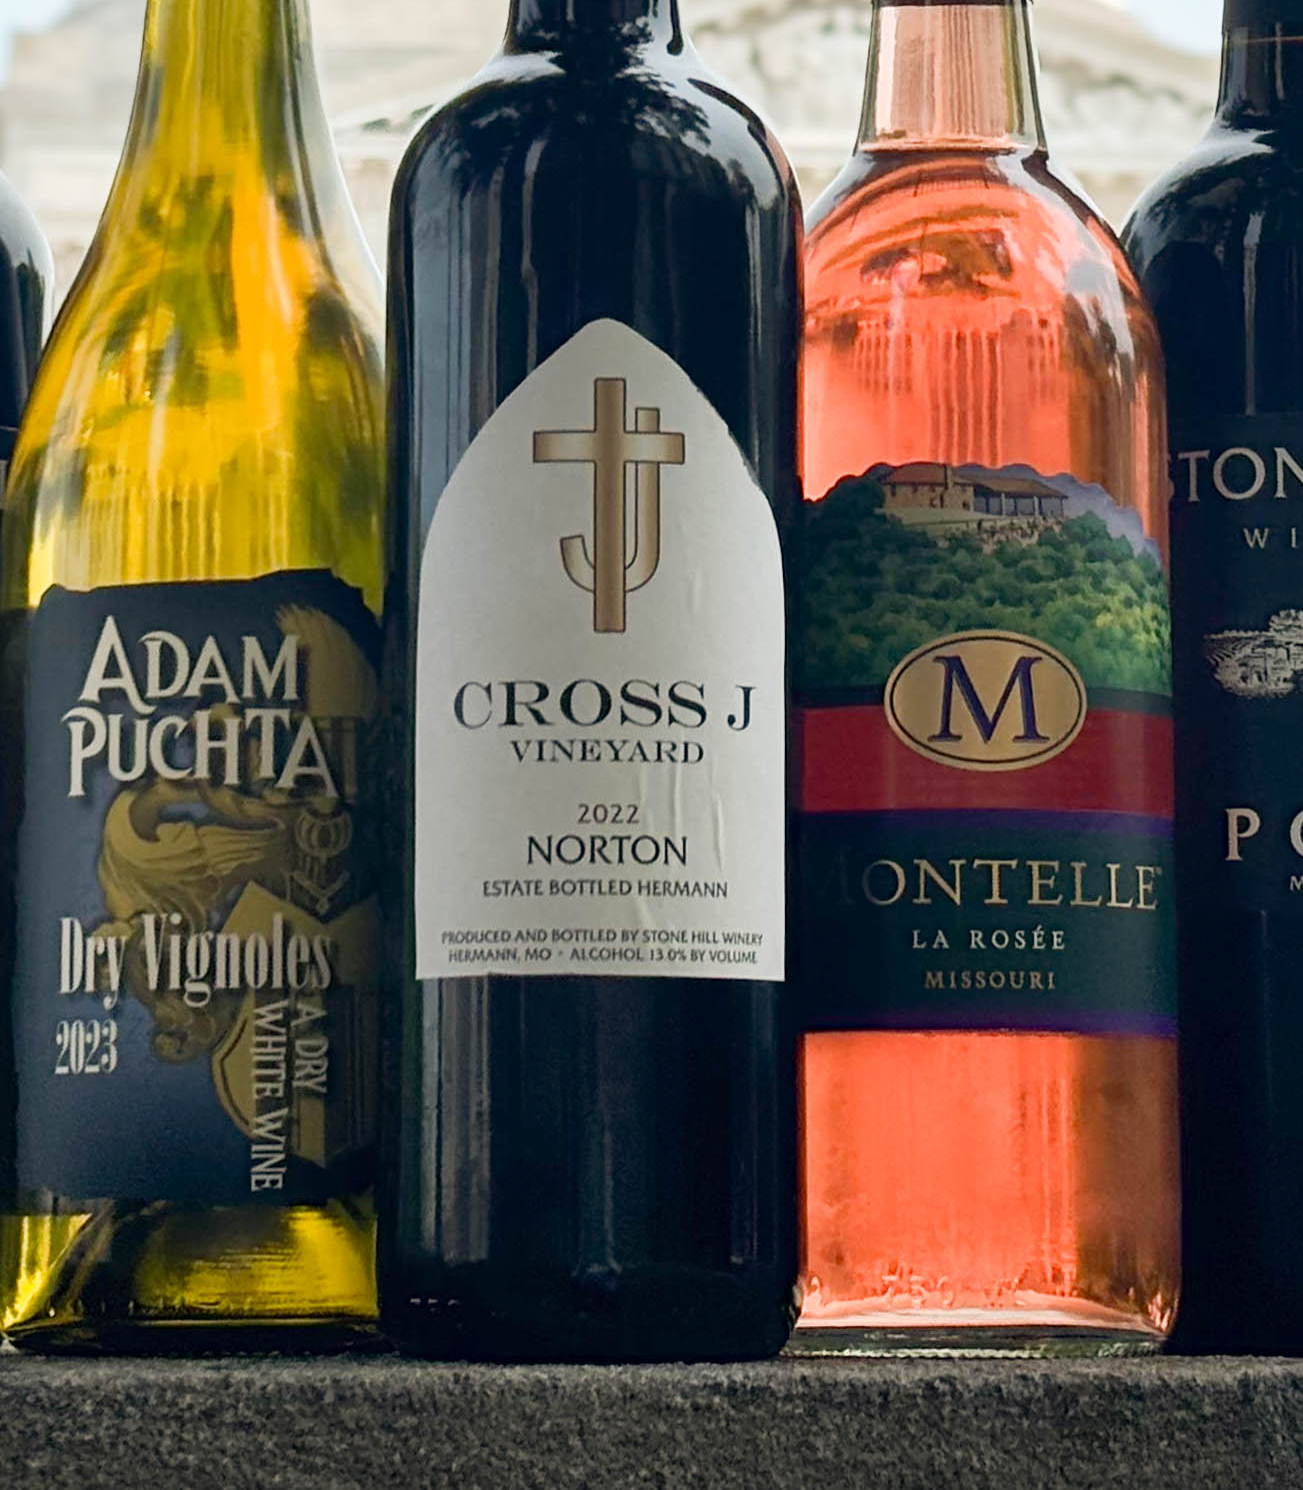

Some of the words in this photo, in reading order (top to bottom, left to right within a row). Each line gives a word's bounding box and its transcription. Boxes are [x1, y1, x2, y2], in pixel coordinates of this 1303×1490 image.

[77, 615, 300, 715] ADAM
[453, 678, 708, 729] CROSS
[727, 685, 757, 731] J
[927, 655, 1050, 744] M
[61, 706, 339, 799] PUCHTA
[509, 739, 705, 764] VINEYARD
[577, 803, 641, 825] 2022
[527, 835, 689, 867] NORTON
[483, 879, 544, 898] ESTATE
[549, 879, 632, 897] BOTTLED
[637, 879, 728, 899] HERMANN
[442, 930, 512, 945] PRODUCED
[515, 928, 547, 943] AND
[551, 928, 617, 943] BOTTLED
[622, 928, 639, 943] BY
[642, 928, 688, 944] STONE
[691, 929, 718, 944] HILL
[722, 931, 764, 946] WINERY
[524, 947, 551, 961] MO
[569, 948, 643, 962] ALCOHOL
[690, 949, 706, 962] BY
[709, 949, 758, 964] VOLUME
[912, 929, 950, 949] LA
[969, 924, 1065, 950] ROSÉE
[59, 917, 128, 1010] Dry
[141, 912, 333, 1008] Vignoles
[924, 970, 1056, 990] MISSOURI
[291, 1001, 327, 1028] A
[54, 1019, 118, 1075] 2023
[250, 998, 290, 1100] WHITE
[292, 1037, 330, 1094] DRY
[250, 1108, 290, 1192] WINE
